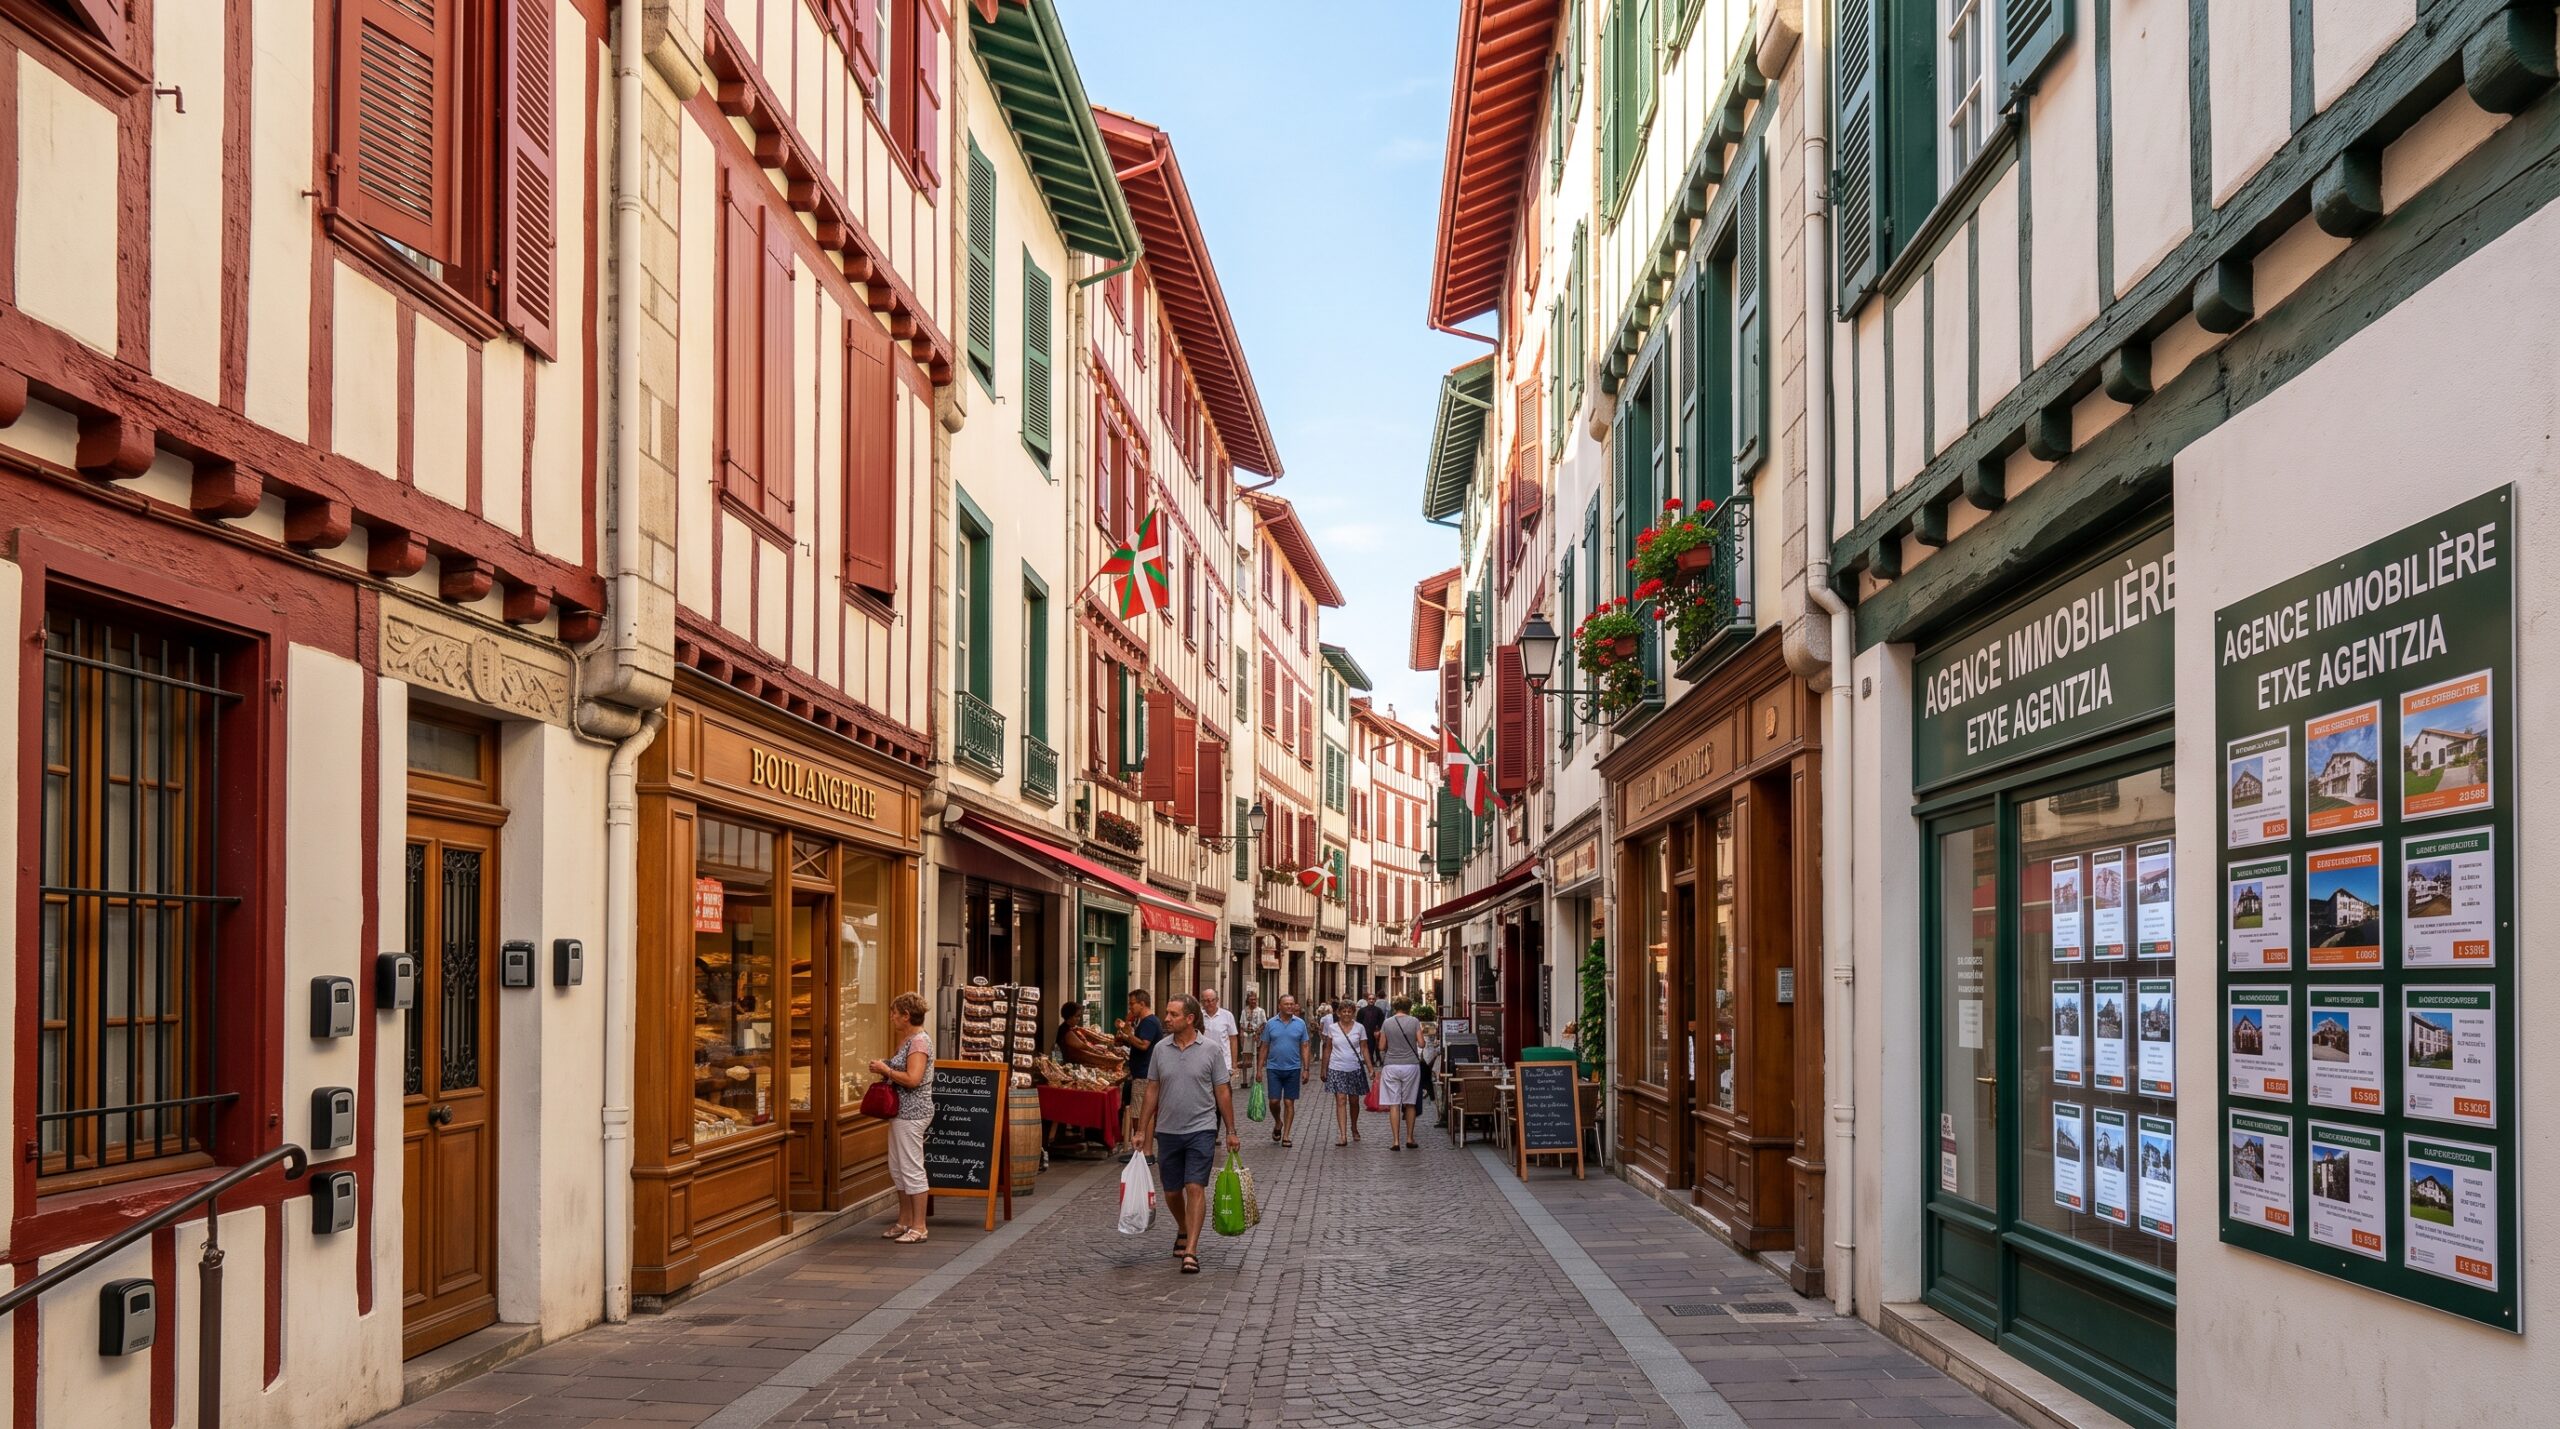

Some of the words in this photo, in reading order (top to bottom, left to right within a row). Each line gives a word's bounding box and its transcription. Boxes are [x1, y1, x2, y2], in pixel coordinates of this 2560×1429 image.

[1924, 640, 2002, 719] AGENCE
[2008, 551, 2175, 681] IMMOBILIÈRE
[2223, 599, 2309, 666] AGENCE
[2316, 521, 2497, 632] IMMOBILIÈRE
[1966, 704, 2008, 756] ETXE
[2012, 663, 2113, 740] AGENTZIA
[2257, 658, 2311, 711] ETXE
[2317, 613, 2448, 699] AGENTZIA
[751, 747, 877, 820] BOULANGERIE
